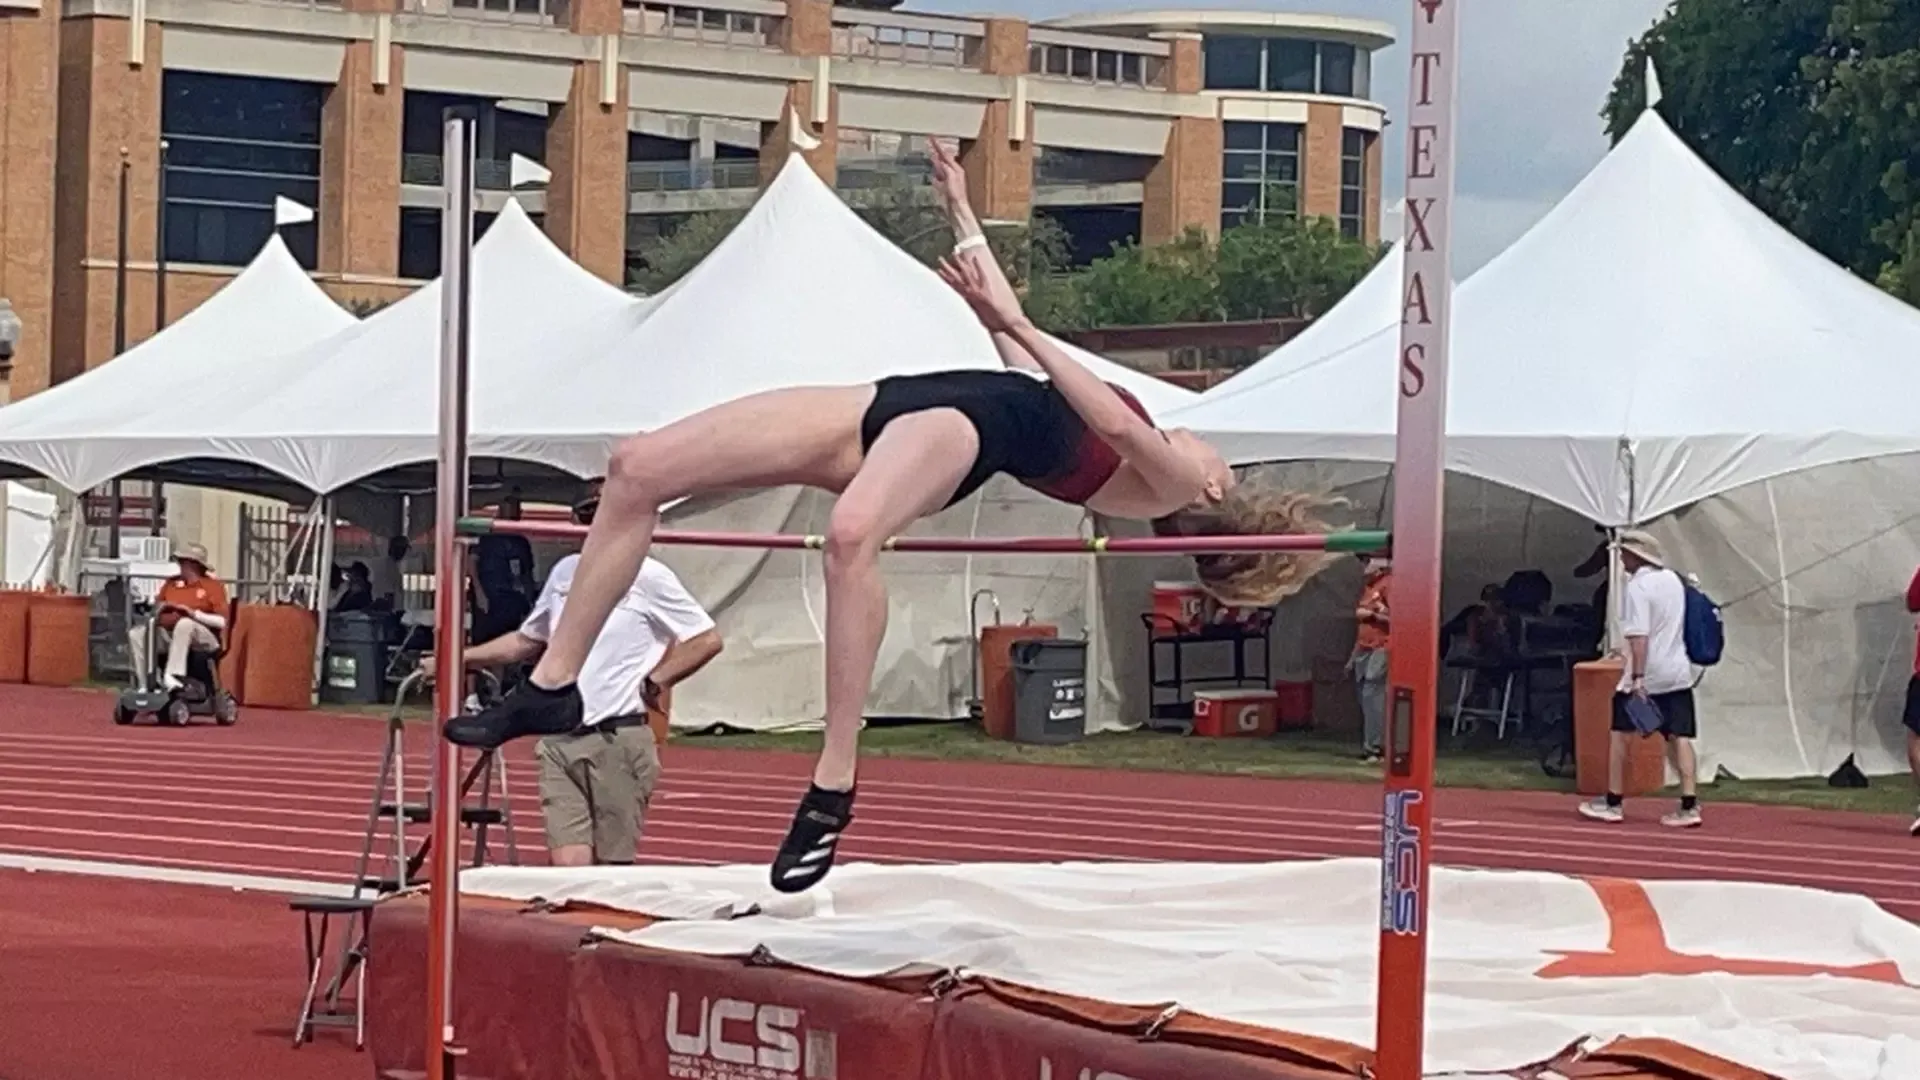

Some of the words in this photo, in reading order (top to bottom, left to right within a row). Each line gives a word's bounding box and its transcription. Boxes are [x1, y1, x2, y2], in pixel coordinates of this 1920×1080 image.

[1400, 52, 1440, 398] TEXAS
[1238, 704, 1260, 731] G
[1394, 789, 1423, 936] UCS
[665, 991, 801, 1072] UCS
